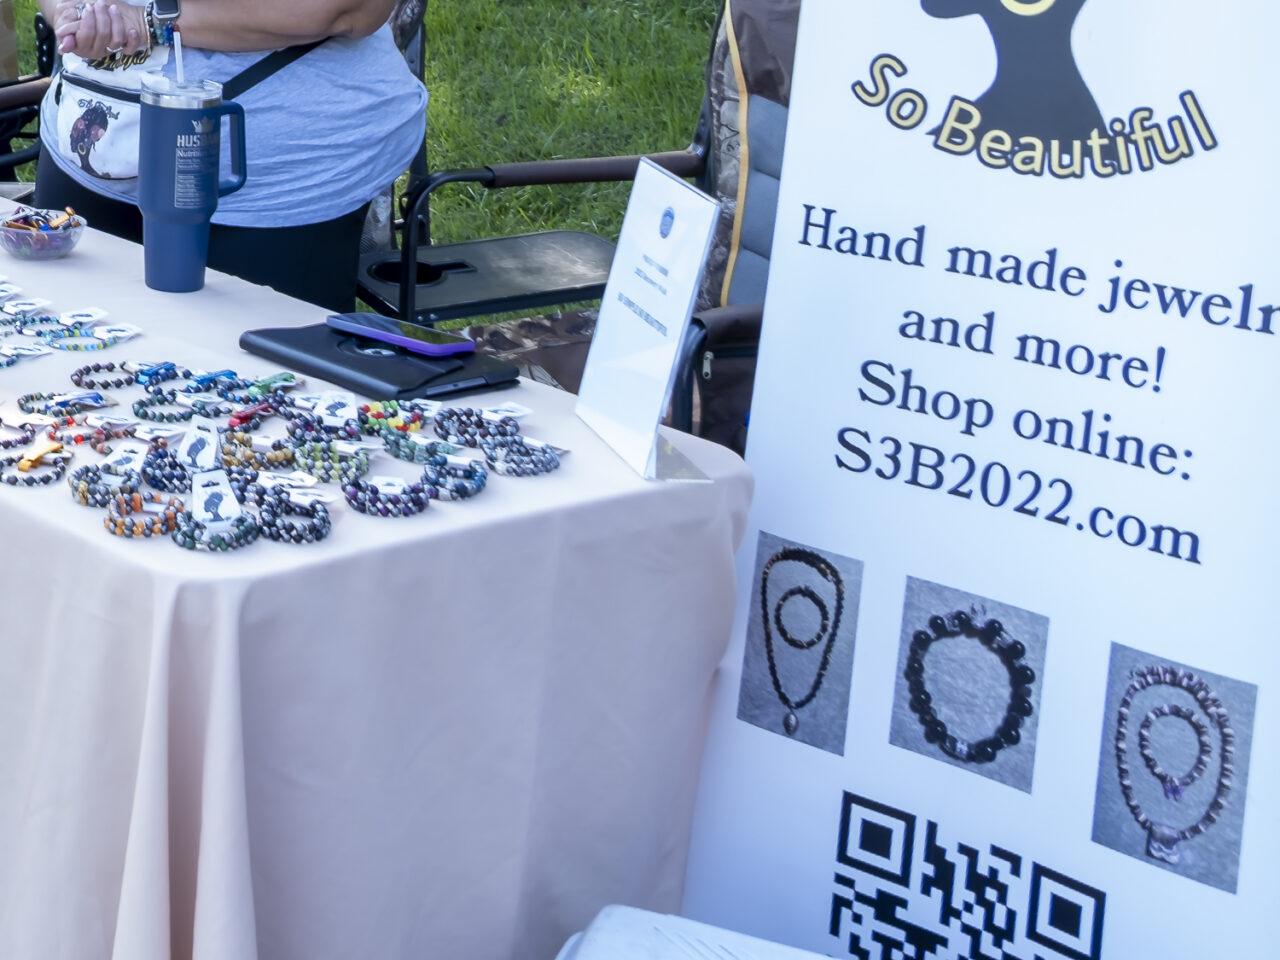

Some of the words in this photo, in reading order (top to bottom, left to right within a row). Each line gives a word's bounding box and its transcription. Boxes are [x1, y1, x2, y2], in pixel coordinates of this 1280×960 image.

[851, 53, 928, 131] So
[933, 89, 1218, 179] Beautiful
[798, 204, 926, 267] Hand
[944, 248, 1087, 297] made
[898, 310, 996, 355] and
[1013, 333, 1166, 393] more!
[857, 359, 994, 436] Shop
[1013, 408, 1193, 480] online:
[834, 426, 1202, 565] S3B2022.com
